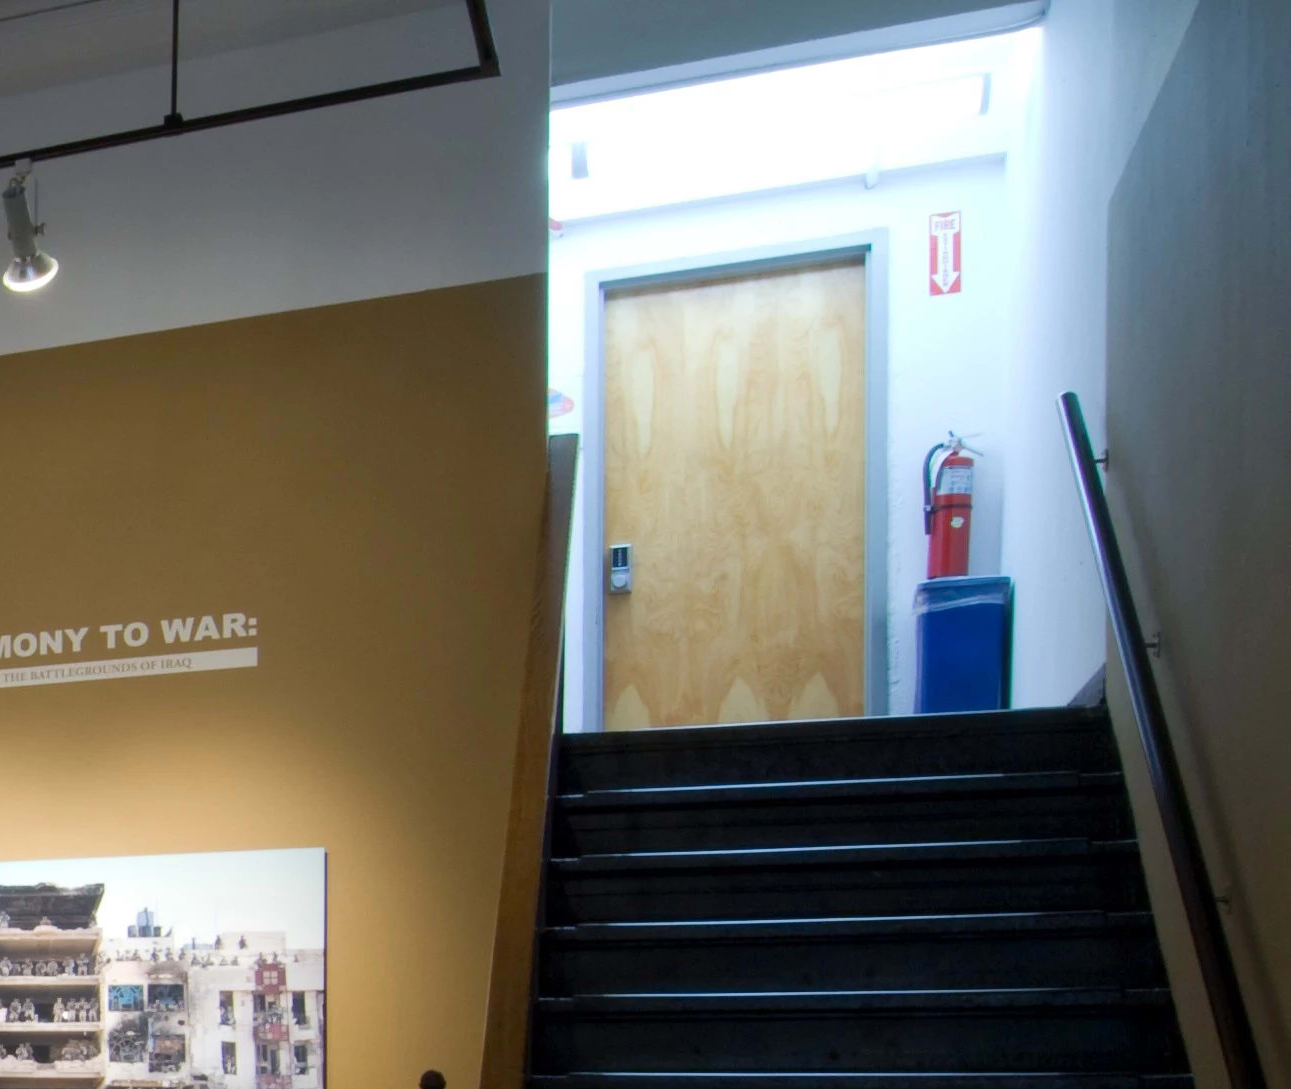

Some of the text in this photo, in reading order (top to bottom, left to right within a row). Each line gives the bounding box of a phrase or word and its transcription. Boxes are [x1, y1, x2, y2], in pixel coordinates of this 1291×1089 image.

[934, 218, 956, 231] FIRE
[99, 622, 149, 650] TO
[160, 612, 258, 643] WAR:
[3, 671, 27, 683] THE
[30, 661, 137, 681] BATTLEGROUNDS
[140, 660, 157, 671] OF
[161, 657, 193, 669] IRAQ
